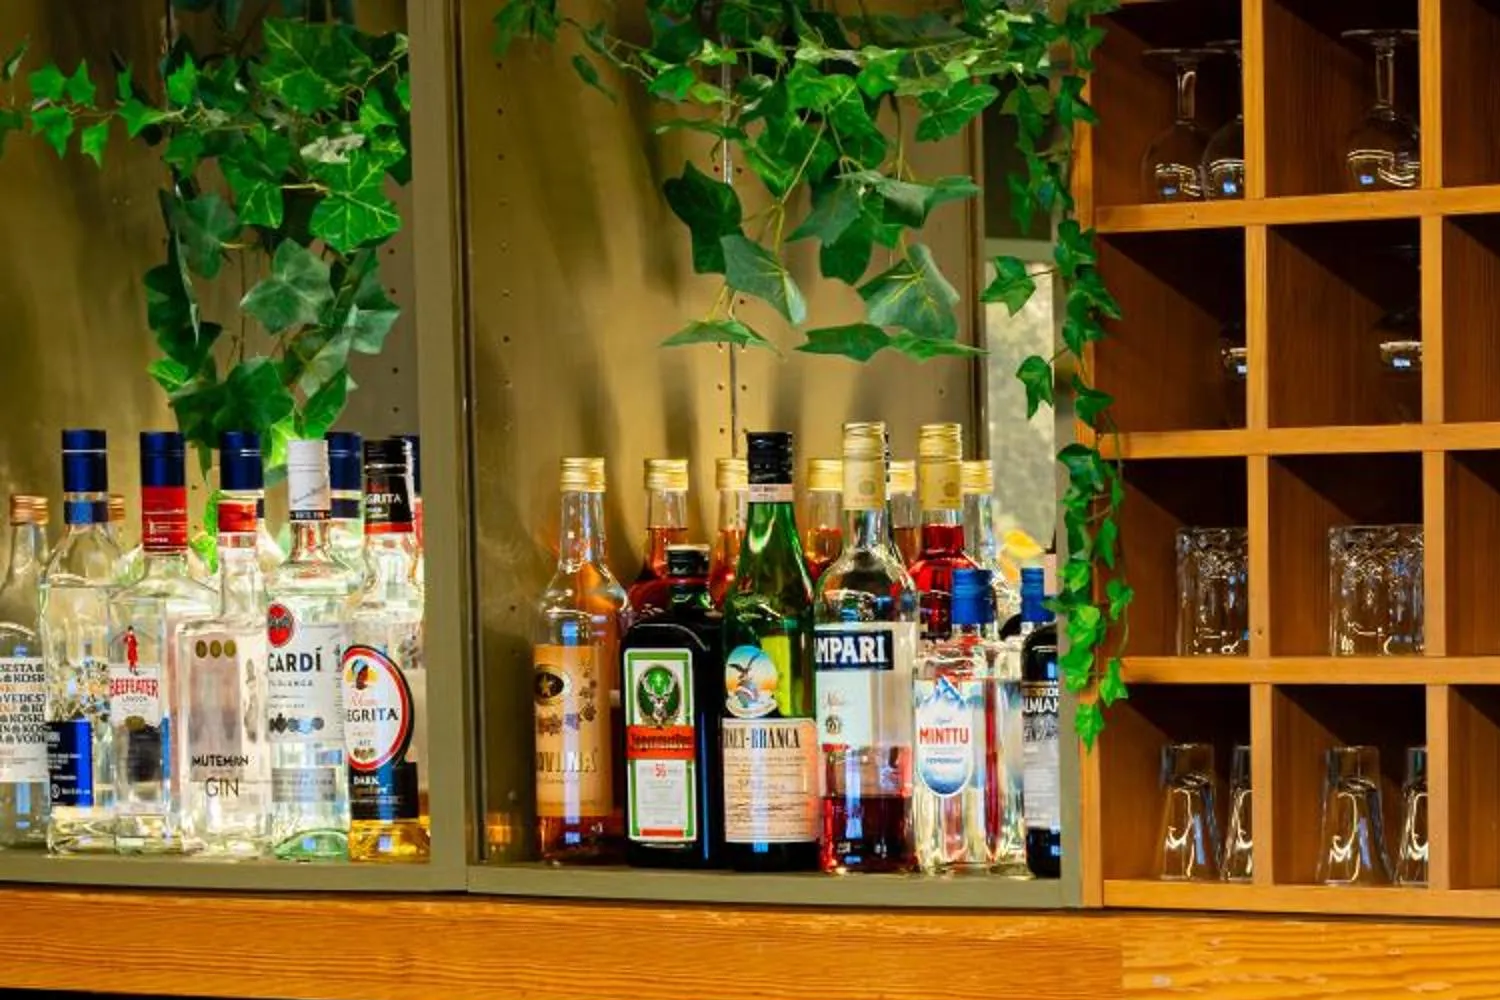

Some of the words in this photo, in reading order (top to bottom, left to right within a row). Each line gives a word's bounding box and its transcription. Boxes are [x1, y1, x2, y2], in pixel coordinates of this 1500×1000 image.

[268, 645, 322, 673] CARDÍ
[816, 636, 887, 664] MPARI
[109, 678, 158, 699] BEEFEATER
[346, 707, 399, 723] EGRITA
[919, 727, 969, 745] MINTTU
[205, 778, 240, 798] GIN
